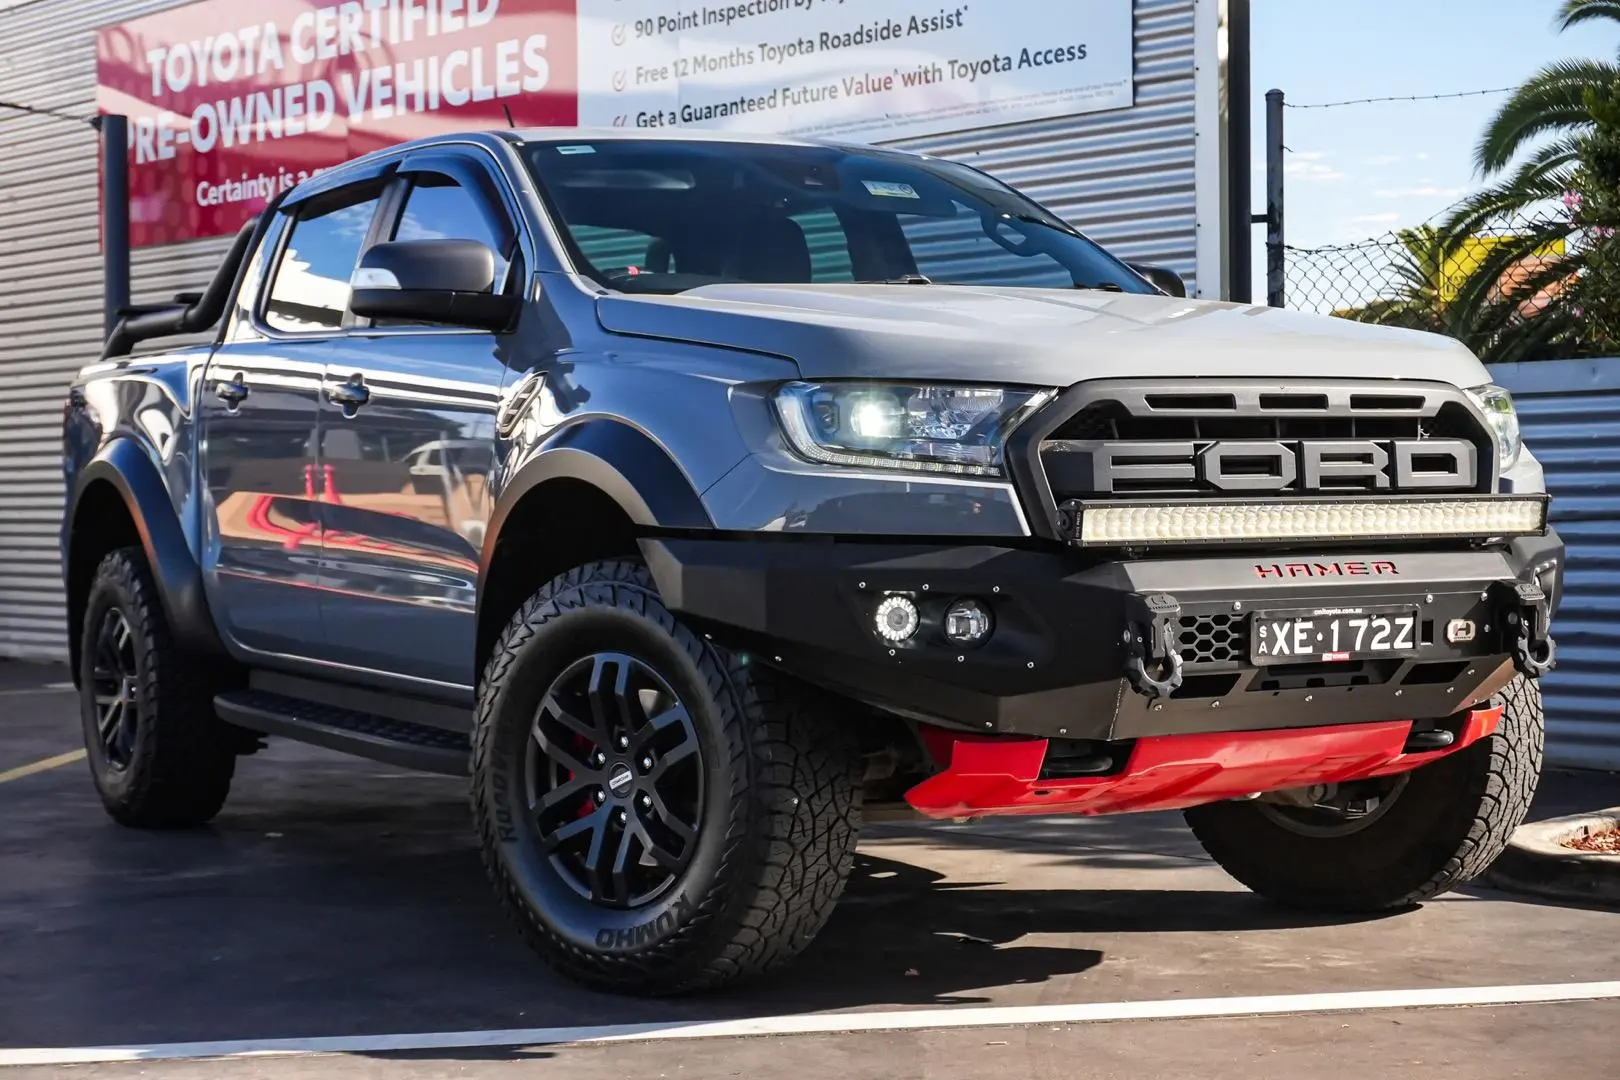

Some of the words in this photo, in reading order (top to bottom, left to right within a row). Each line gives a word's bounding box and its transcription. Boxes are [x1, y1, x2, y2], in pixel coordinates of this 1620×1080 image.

[147, 22, 284, 97] TOYOTA
[290, 0, 499, 65] CERTIFIED
[635, 20, 653, 38] 90
[658, 11, 698, 34] Point
[702, 0, 789, 25] Inspection
[342, 34, 549, 124] VEHICLES
[636, 66, 668, 85] Free
[673, 58, 689, 77] 12
[693, 47, 754, 74] Months
[758, 37, 814, 65] Toyota
[819, 19, 902, 51] Roadside
[636, 109, 664, 128] Get
[668, 111, 677, 125] a
[681, 88, 777, 122] Guaranteed
[782, 85, 838, 107] Future
[902, 63, 942, 87] with
[948, 54, 1012, 82] Toyota
[1018, 43, 1087, 69] Access
[196, 172, 276, 206] Certainty
[279, 166, 294, 192] is
[1093, 440, 1478, 492] FORD
[1254, 560, 1400, 578] HAMER
